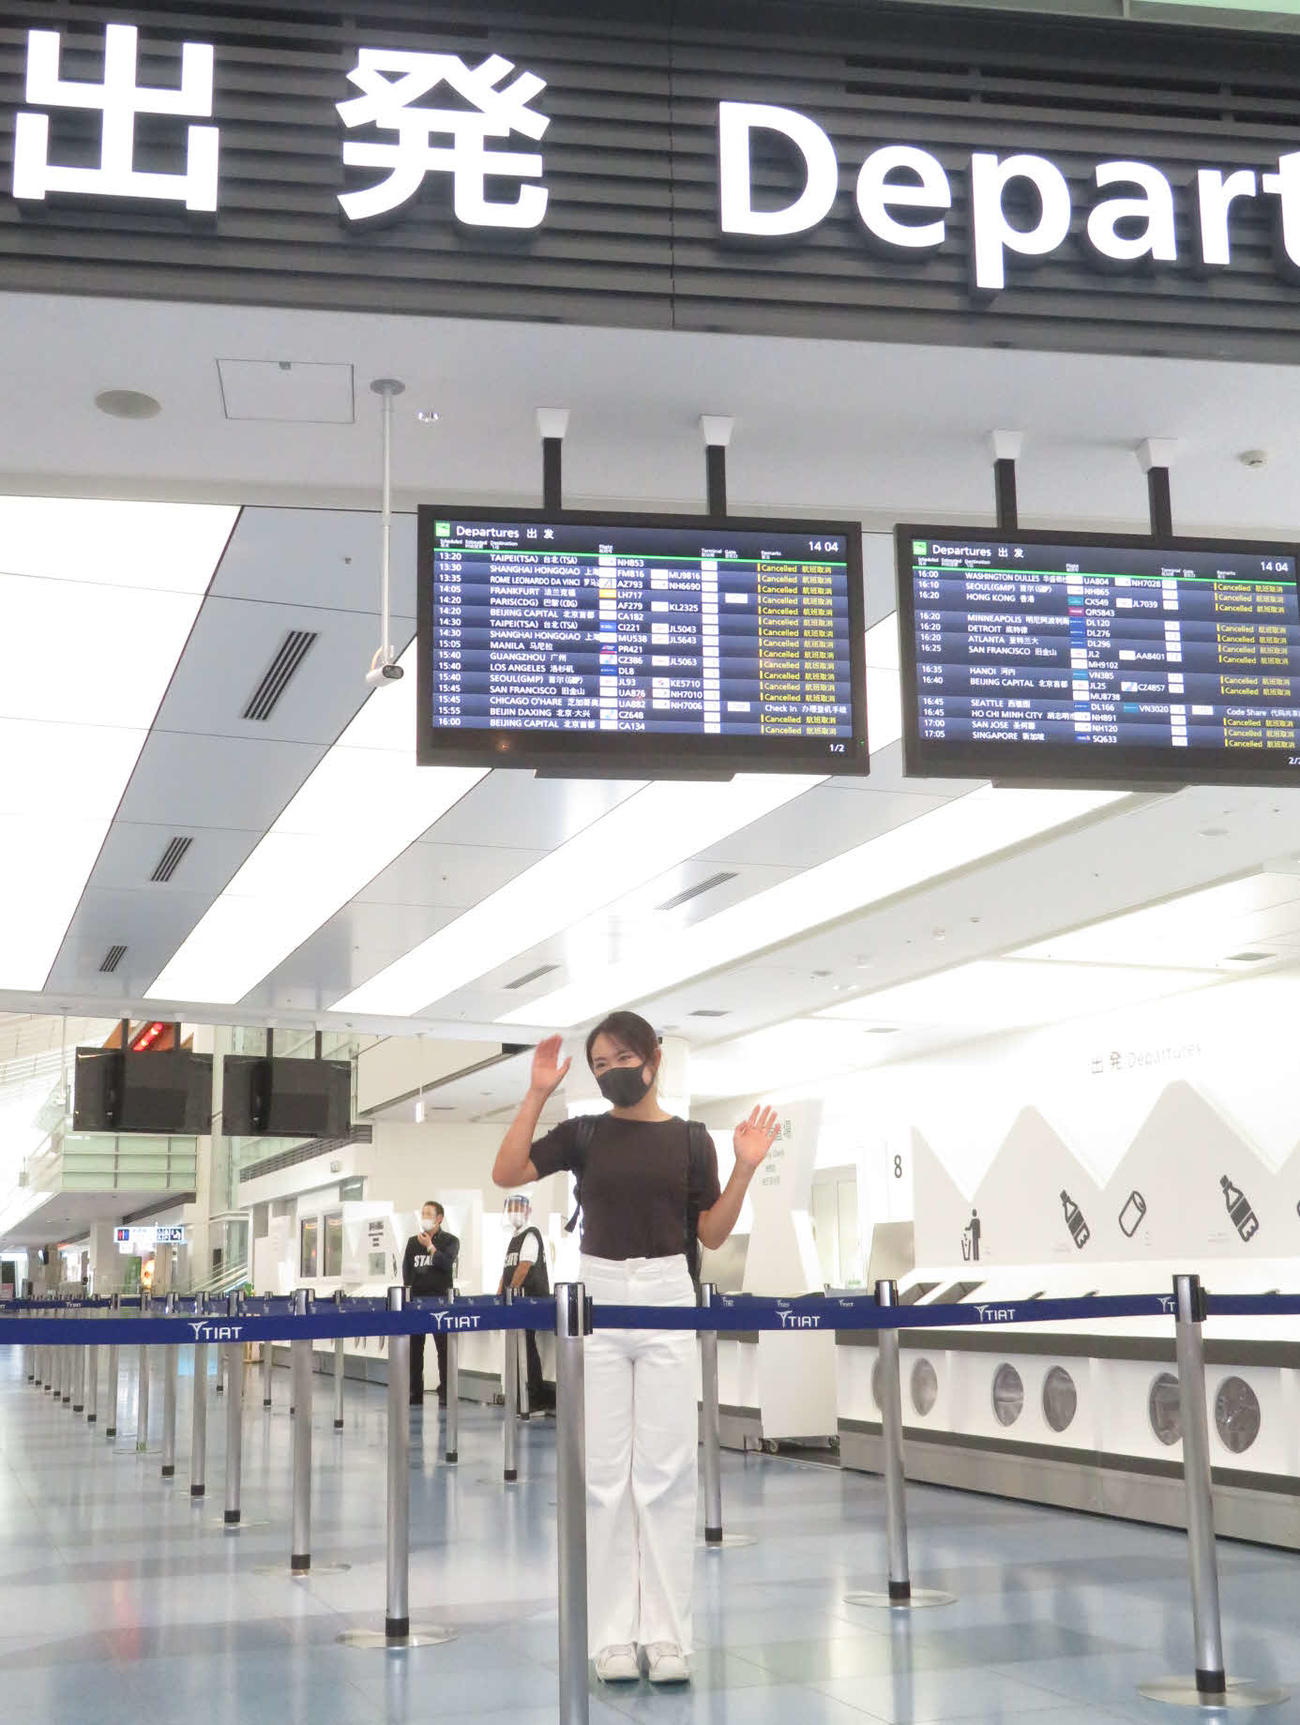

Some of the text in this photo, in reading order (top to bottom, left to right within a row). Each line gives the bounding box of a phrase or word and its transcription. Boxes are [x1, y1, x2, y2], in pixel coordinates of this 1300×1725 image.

[719, 101, 1300, 289] Depart
[456, 526, 520, 538] Departures
[932, 544, 991, 557] Departures
[440, 563, 461, 571] 13:30
[762, 565, 797, 573] Cancelled
[440, 574, 461, 582] 13:35
[762, 586, 797, 594] Cancelled
[1218, 583, 1250, 591] Cancelled
[440, 596, 461, 604] 14:20
[490, 598, 538, 606] PARIS(CDG)
[762, 597, 798, 605] Cancelled
[920, 591, 939, 599] 16:20
[1219, 604, 1252, 612] Cancelled
[763, 618, 798, 626] Cancelled
[440, 618, 461, 626] 14:30
[763, 629, 798, 637] Cancelled
[1221, 624, 1254, 632] Cancelled
[1222, 635, 1254, 643] Cancelled
[764, 640, 799, 648] Cancelled
[1222, 645, 1255, 653] Cancelled
[490, 653, 545, 661] GUANGZHOU
[764, 651, 799, 659] Cancelled
[440, 662, 461, 670] 15:40
[508, 664, 546, 672] ANGELES
[764, 672, 800, 680] Cancelled
[440, 673, 460, 681] 15:40
[764, 683, 800, 691] Cancelled
[1224, 676, 1257, 684] Cancelled
[440, 684, 460, 692] 15:45
[765, 694, 800, 702] Cancelled
[1225, 687, 1258, 695] Cancelled
[440, 695, 460, 703] 15:45
[971, 699, 1002, 707] SEATTLE
[765, 716, 801, 724] Cancelled
[1228, 718, 1261, 726] Cancelled
[766, 726, 801, 734] Cancelled
[925, 719, 945, 727] 17:00
[1228, 729, 1262, 737] Cancelled
[829, 744, 845, 752] 1/2
[894, 1154, 902, 1178] 8
[414, 1254, 433, 1268] STA
